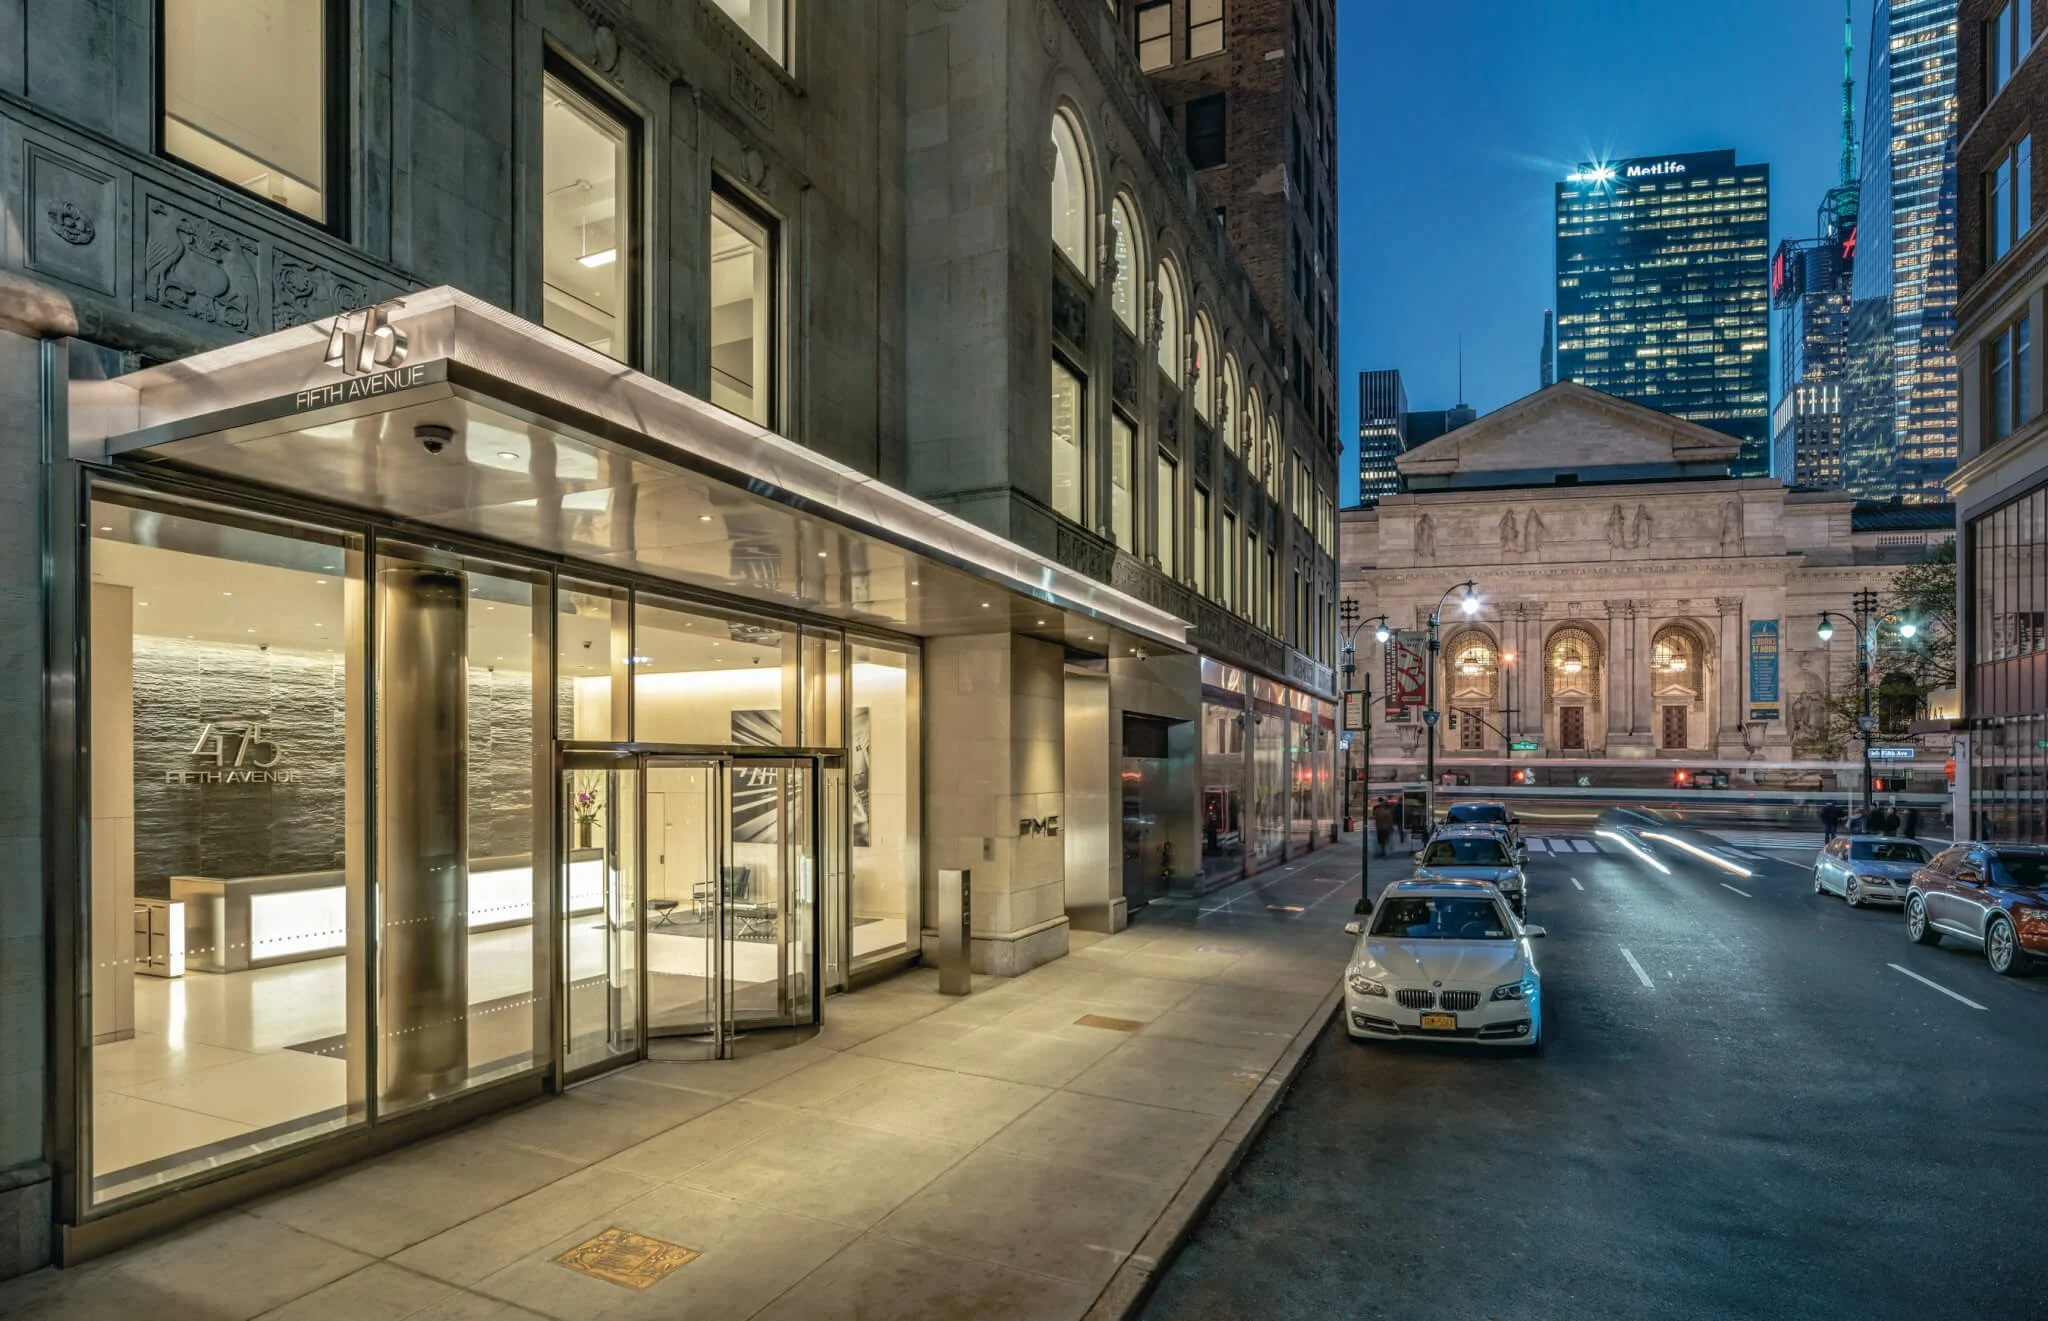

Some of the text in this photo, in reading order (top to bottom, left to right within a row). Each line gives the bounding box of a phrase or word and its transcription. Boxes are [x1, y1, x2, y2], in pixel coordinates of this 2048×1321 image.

[1627, 161, 1685, 177] MetLife
[324, 300, 409, 376] 475
[296, 365, 425, 410] FIFTH AVENUE
[191, 723, 283, 768] 475
[164, 770, 301, 784] FIFTH AVENUE
